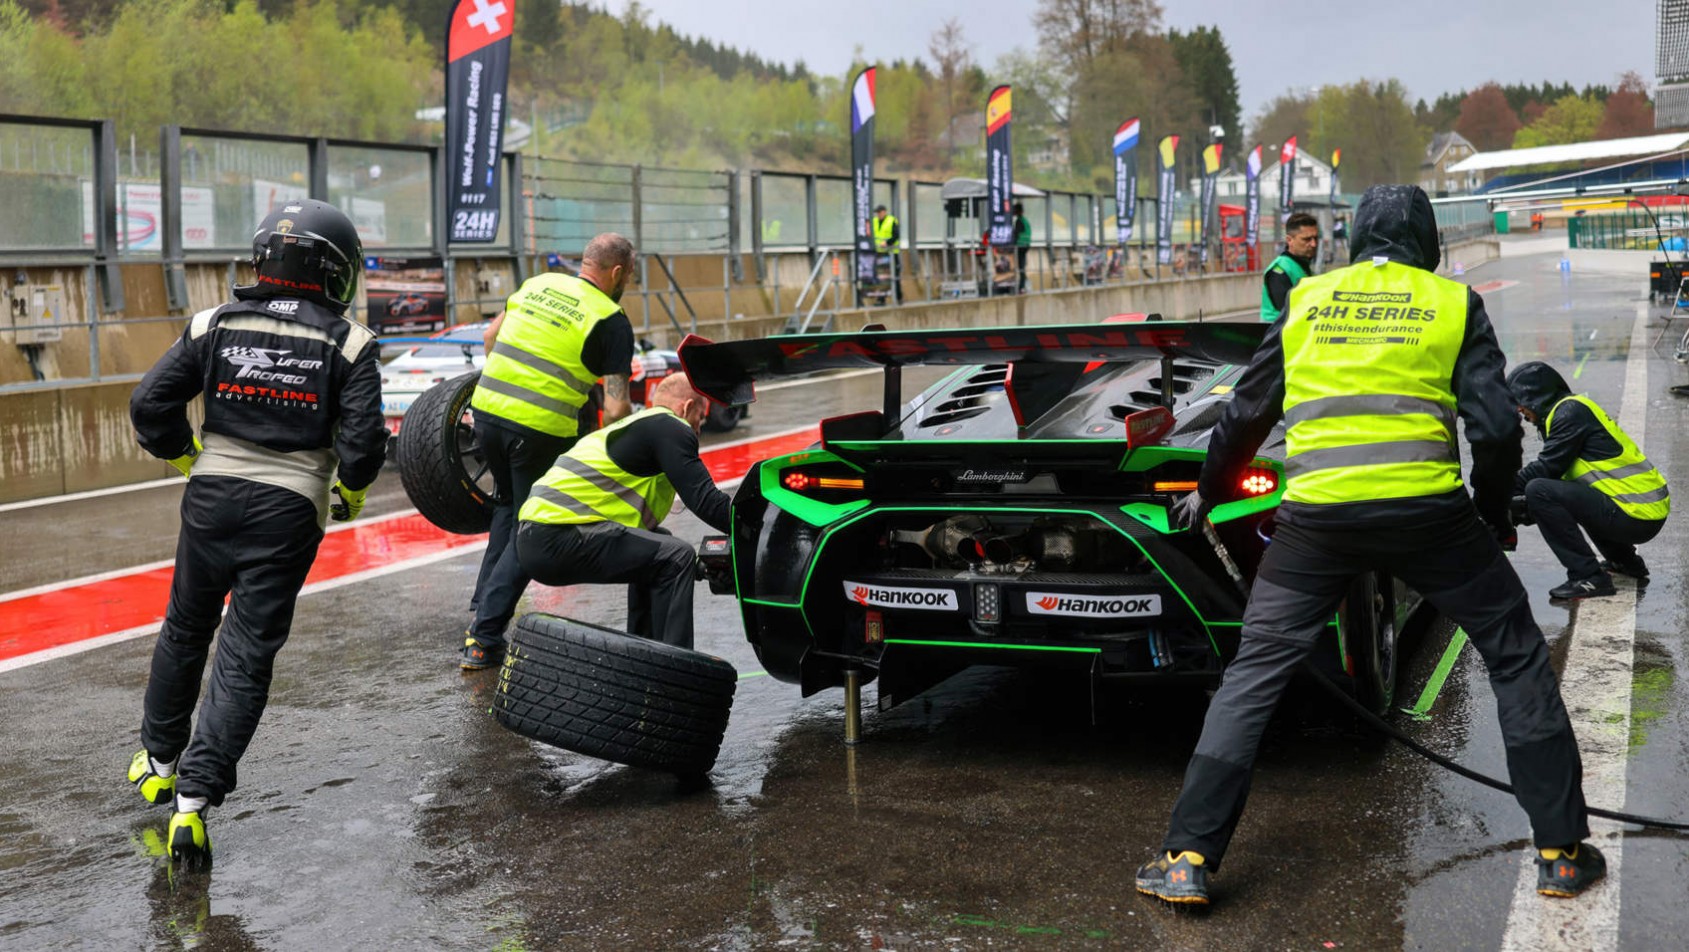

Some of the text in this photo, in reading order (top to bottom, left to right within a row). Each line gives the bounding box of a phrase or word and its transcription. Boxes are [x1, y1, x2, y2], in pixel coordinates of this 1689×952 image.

[462, 60, 483, 187] Wolf-Power Racing
[455, 211, 495, 230] 24H
[454, 230, 492, 238] SERIES
[259, 275, 322, 291] FASTLINE
[267, 302, 299, 313] OMP
[545, 299, 585, 321] SERIES
[1306, 306, 1437, 322] 24H SERIES
[1313, 323, 1423, 334] #thisisendurance
[779, 329, 1191, 361] FASTLINE
[216, 391, 318, 411] advertising
[217, 382, 318, 403] FASTLINE
[957, 469, 1024, 483] Lamborghini
